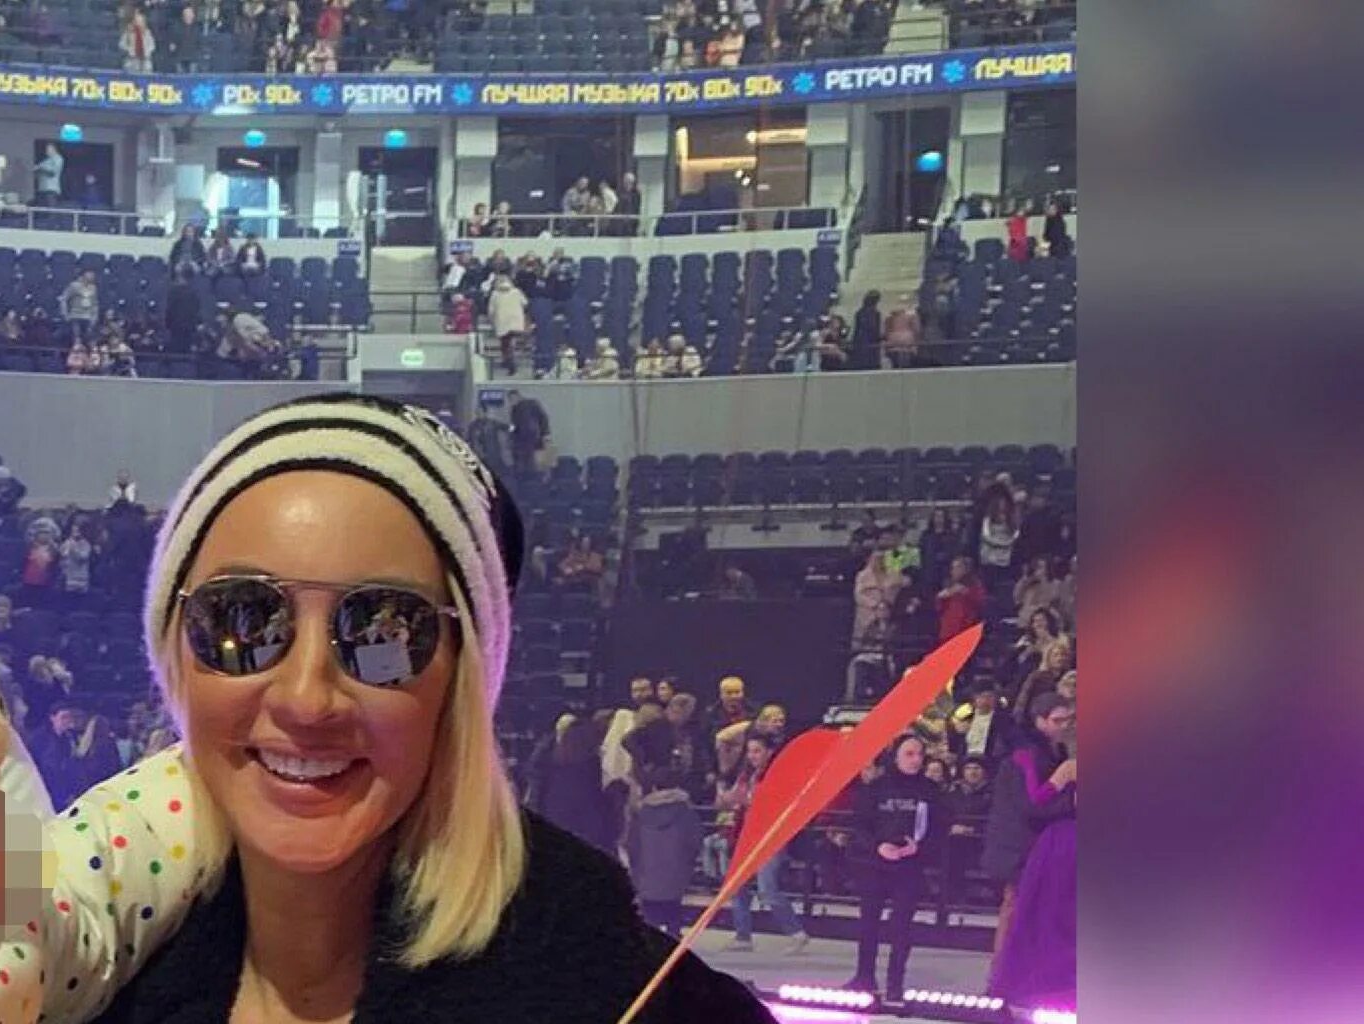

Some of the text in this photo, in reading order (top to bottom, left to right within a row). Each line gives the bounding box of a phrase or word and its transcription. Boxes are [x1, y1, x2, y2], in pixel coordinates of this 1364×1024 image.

[825, 63, 933, 90] РЕТРО FM
[975, 53, 1072, 80] ЛУЧШАЯ
[342, 85, 441, 104] РЕТРО FM
[482, 84, 569, 103] ЛУЧШАЯ
[573, 83, 660, 103] МУЗЫКА
